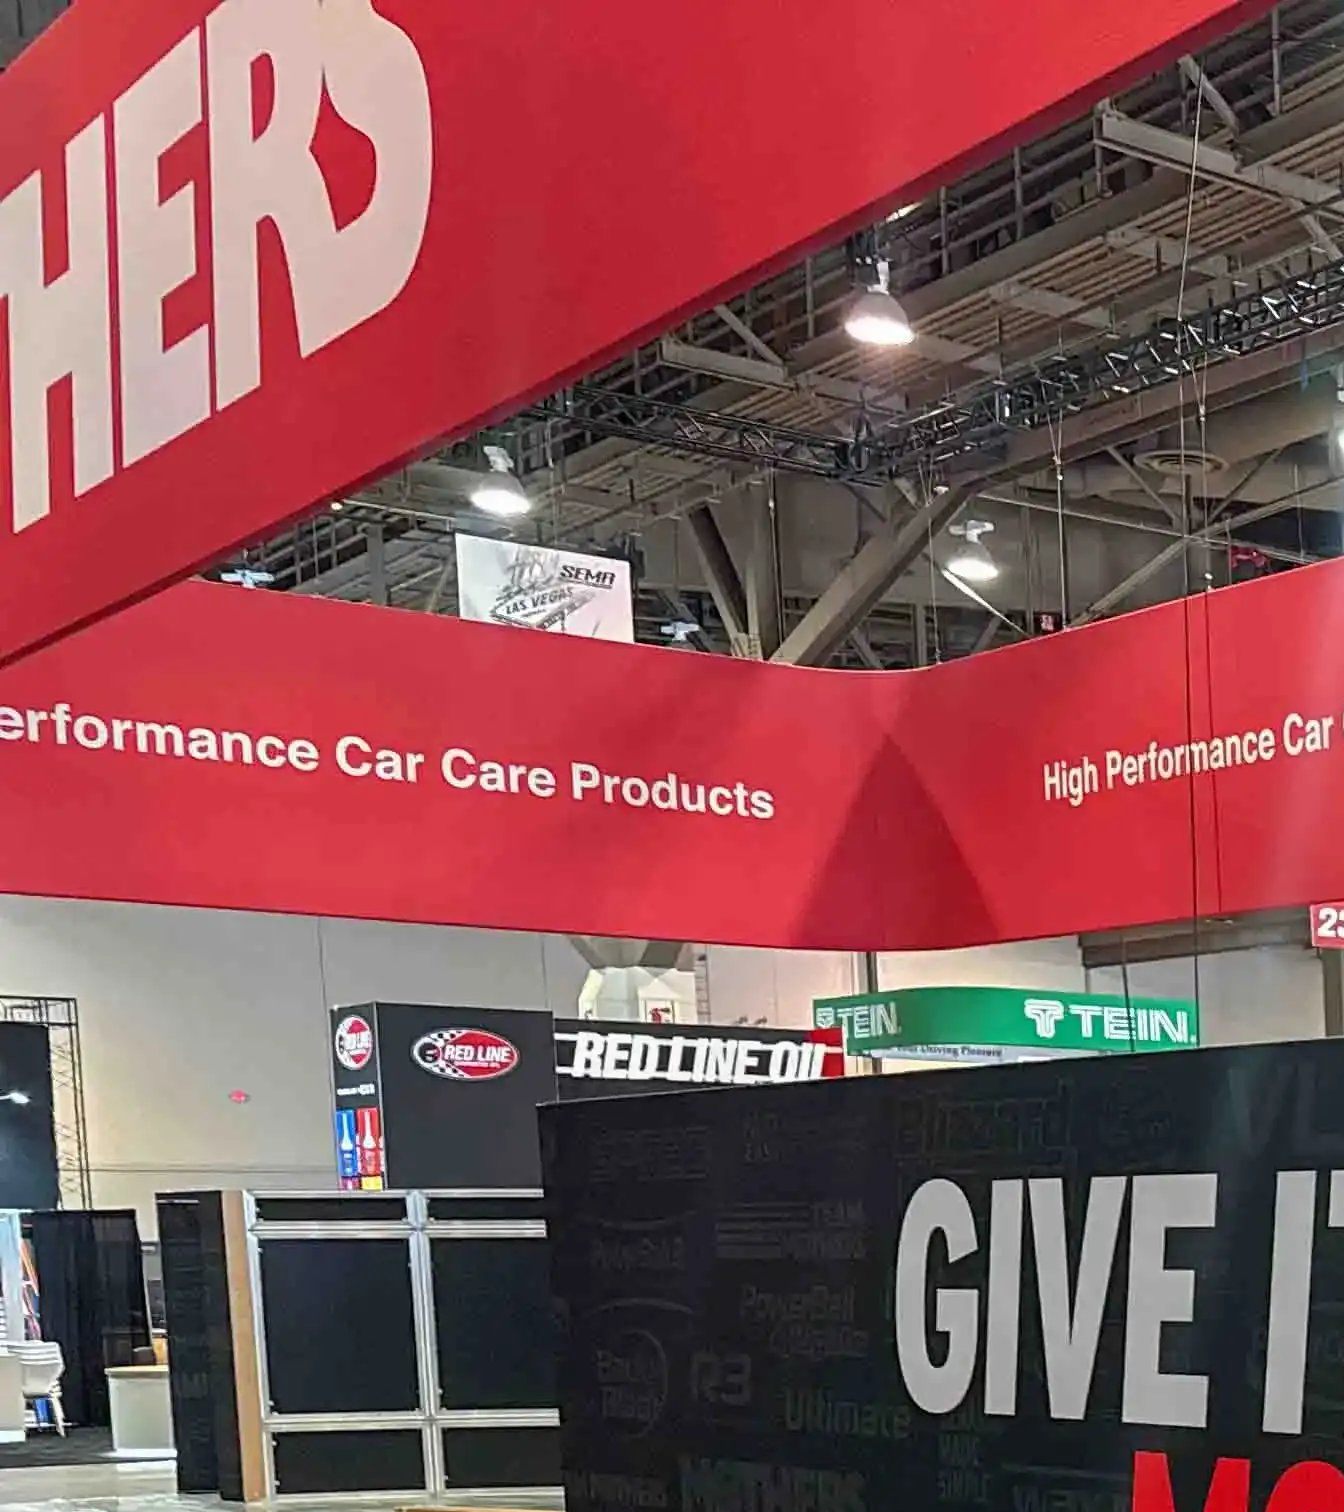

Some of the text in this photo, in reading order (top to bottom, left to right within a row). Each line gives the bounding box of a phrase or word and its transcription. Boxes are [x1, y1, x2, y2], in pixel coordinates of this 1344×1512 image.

[0, 0, 432, 534] HERS
[505, 602, 528, 615] LAS
[336, 736, 426, 783] Car
[442, 749, 557, 798] Care
[572, 763, 775, 820] Products
[1045, 757, 1100, 807] High
[1107, 729, 1276, 789] Performance
[1284, 713, 1335, 757] Car
[840, 1002, 898, 1038] TEIN
[1069, 1005, 1191, 1043] TEIN
[444, 1046, 512, 1063] RED LINE
[572, 1032, 657, 1079] RED
[666, 1036, 765, 1085] LINE
[893, 1171, 1220, 1430] GIVE
